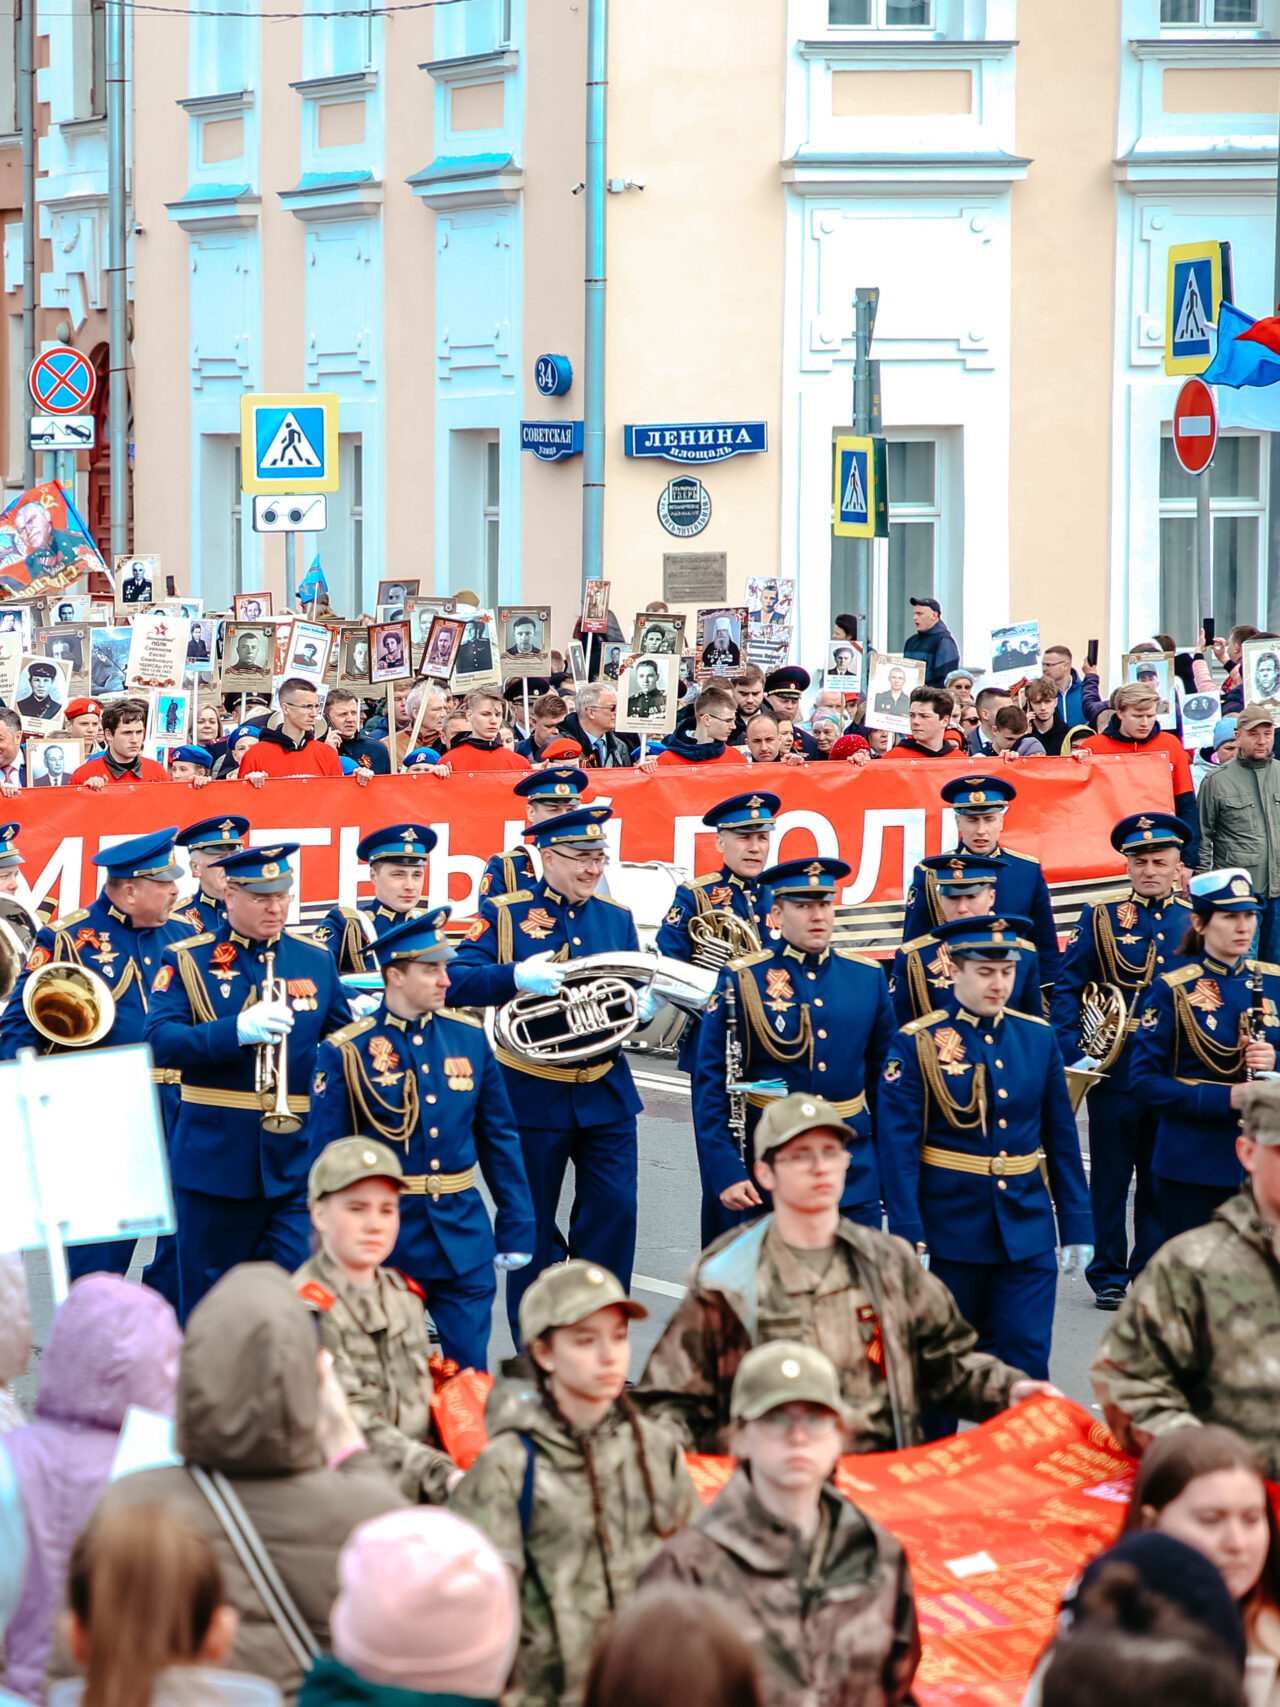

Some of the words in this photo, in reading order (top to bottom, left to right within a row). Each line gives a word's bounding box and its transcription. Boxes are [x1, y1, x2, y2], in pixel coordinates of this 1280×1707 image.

[538, 361, 553, 388] 34
[523, 426, 571, 444] СОВЕТСКАЯ
[644, 427, 753, 447] ЛЕНИНА
[538, 445, 557, 455] улица
[670, 445, 733, 460] площадь
[673, 805, 1010, 906] ПОЛ
